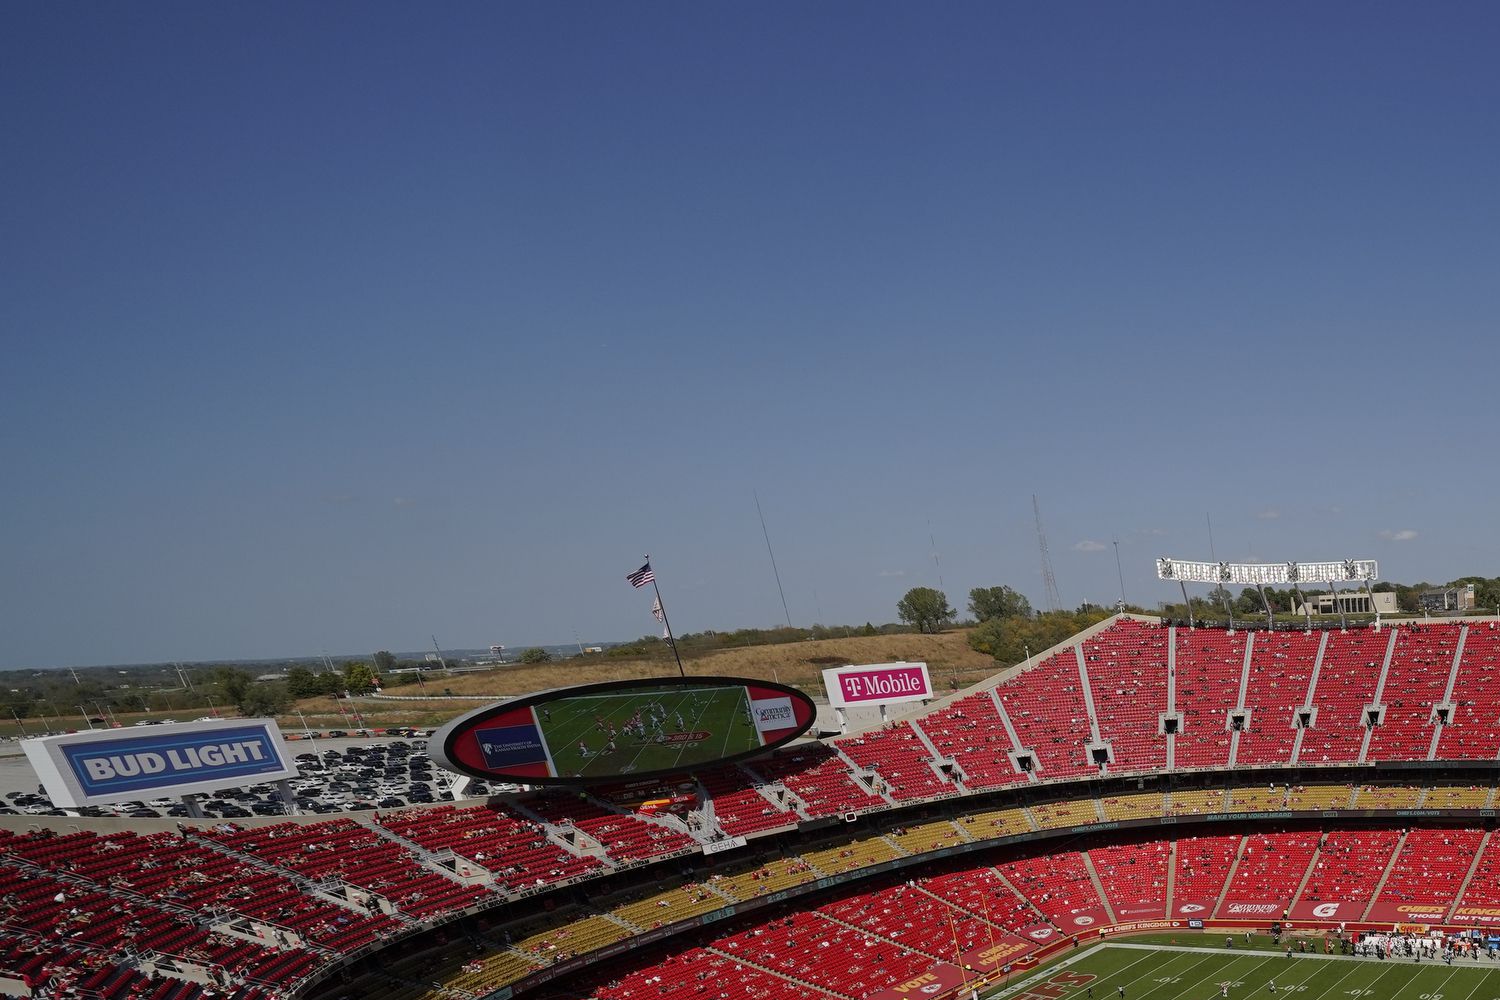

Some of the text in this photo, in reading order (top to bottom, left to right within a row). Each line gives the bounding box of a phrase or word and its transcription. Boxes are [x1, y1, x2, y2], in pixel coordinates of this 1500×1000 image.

[862, 673, 921, 696] Mobile
[83, 740, 268, 781] BUD LIGHT
[710, 840, 738, 852] GEHA
[672, 849, 692, 858] WILSON
[614, 864, 632, 873] HANK
[1228, 903, 1281, 912] Community
[1396, 905, 1447, 914] CHIEFS
[1114, 923, 1137, 932] CHIEFS
[1137, 921, 1171, 930] KINGDOM
[977, 942, 1011, 959] CHIEFS
[979, 943, 1028, 966] KINGDOM
[893, 973, 938, 993] VOTE
